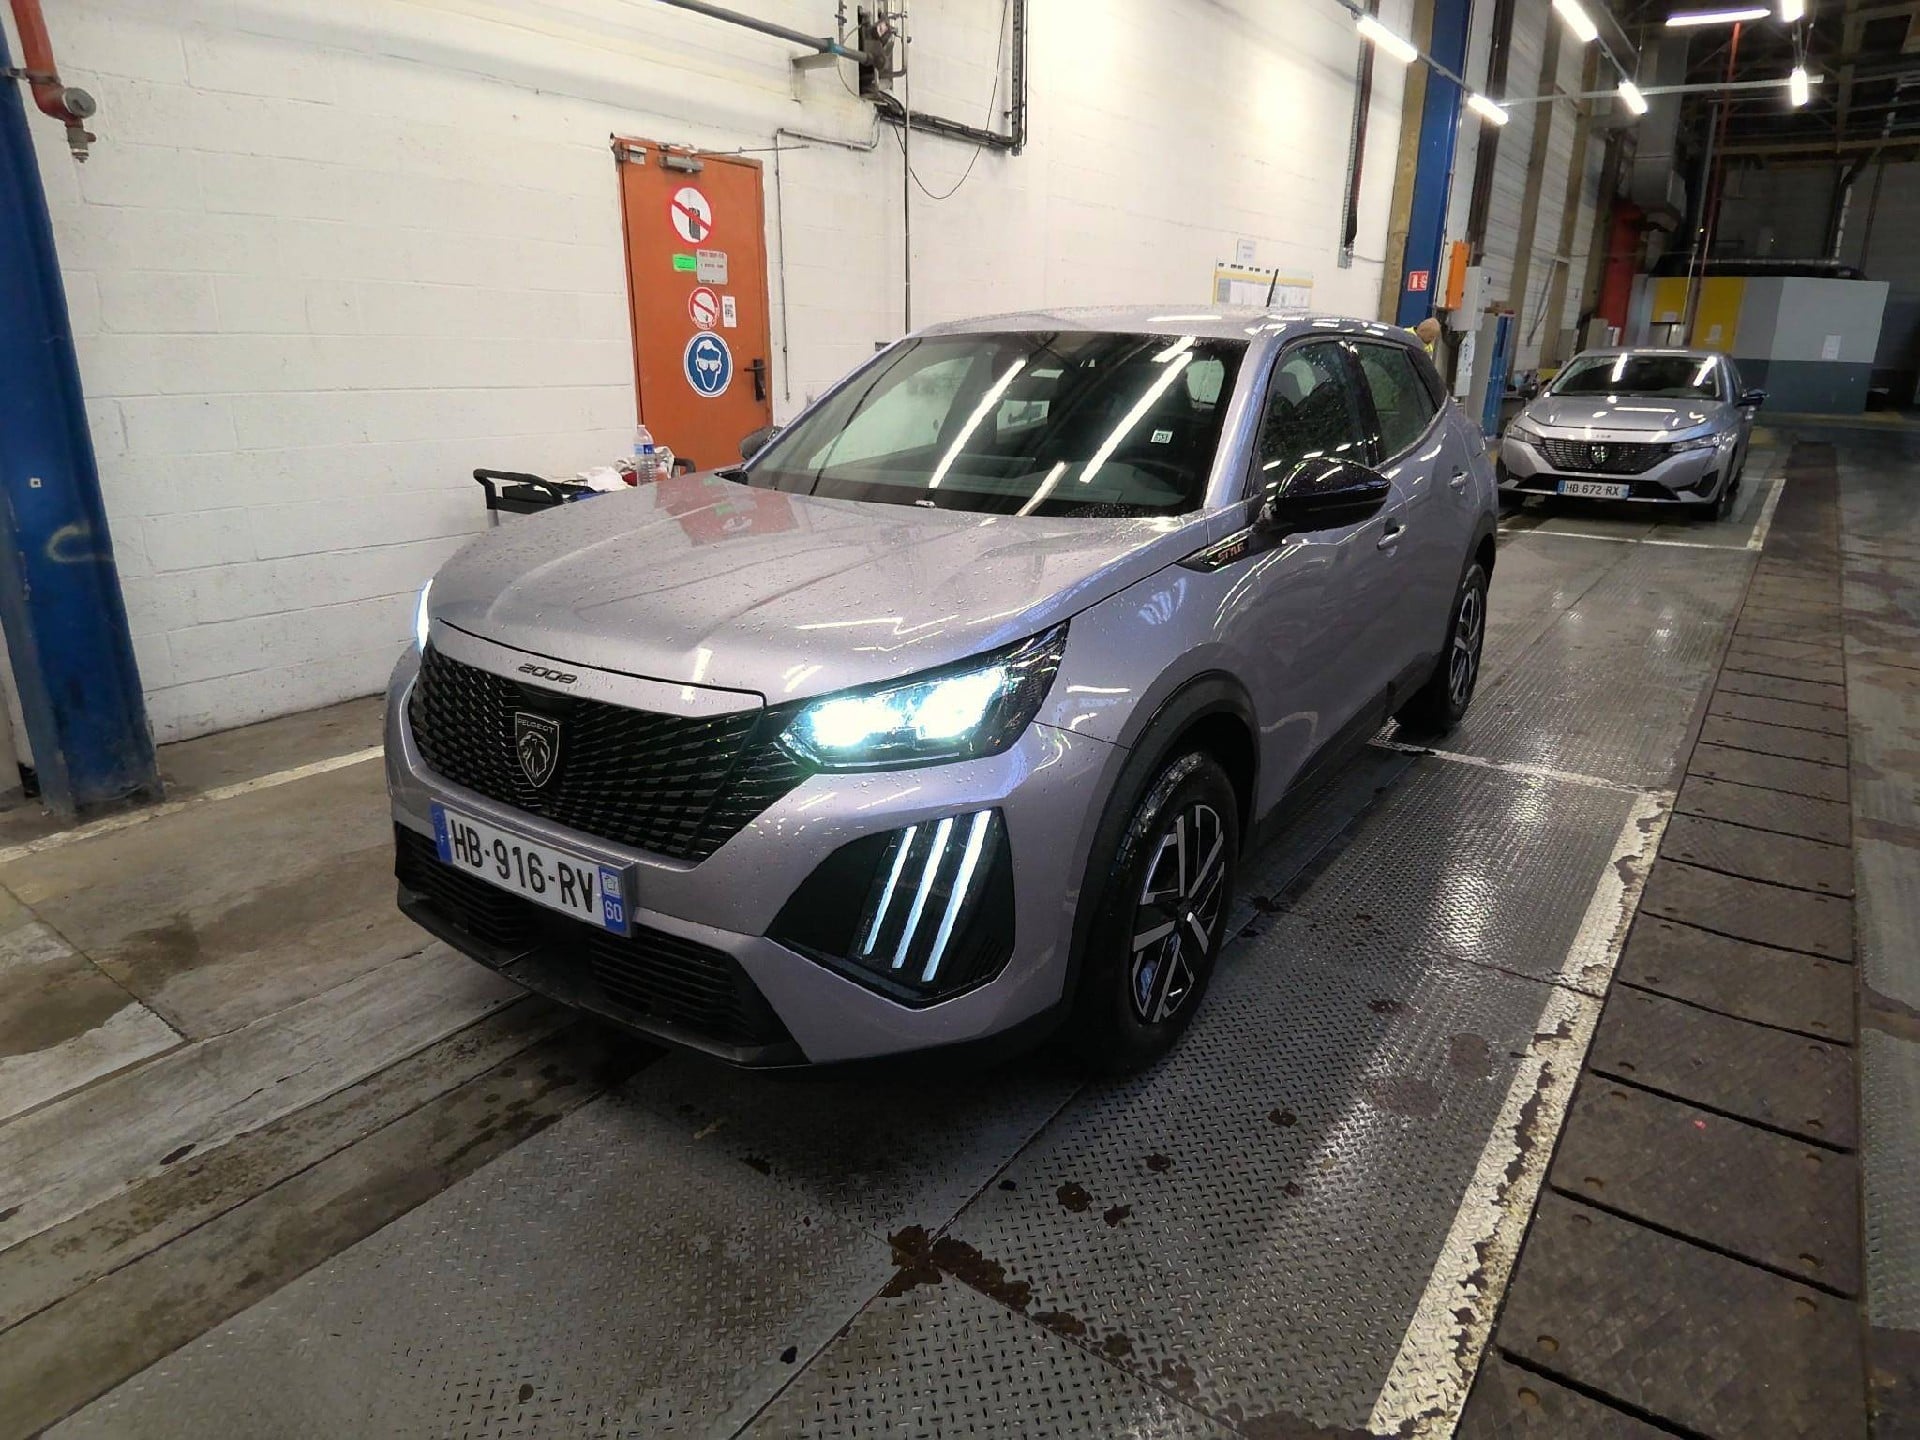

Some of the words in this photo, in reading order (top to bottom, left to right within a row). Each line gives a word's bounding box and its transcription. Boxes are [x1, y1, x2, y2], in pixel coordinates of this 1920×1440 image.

[518, 663, 578, 684] 2008
[517, 718, 554, 733] PEUGEOT
[450, 818, 594, 914] HB-916-RV
[604, 900, 623, 923] 60
